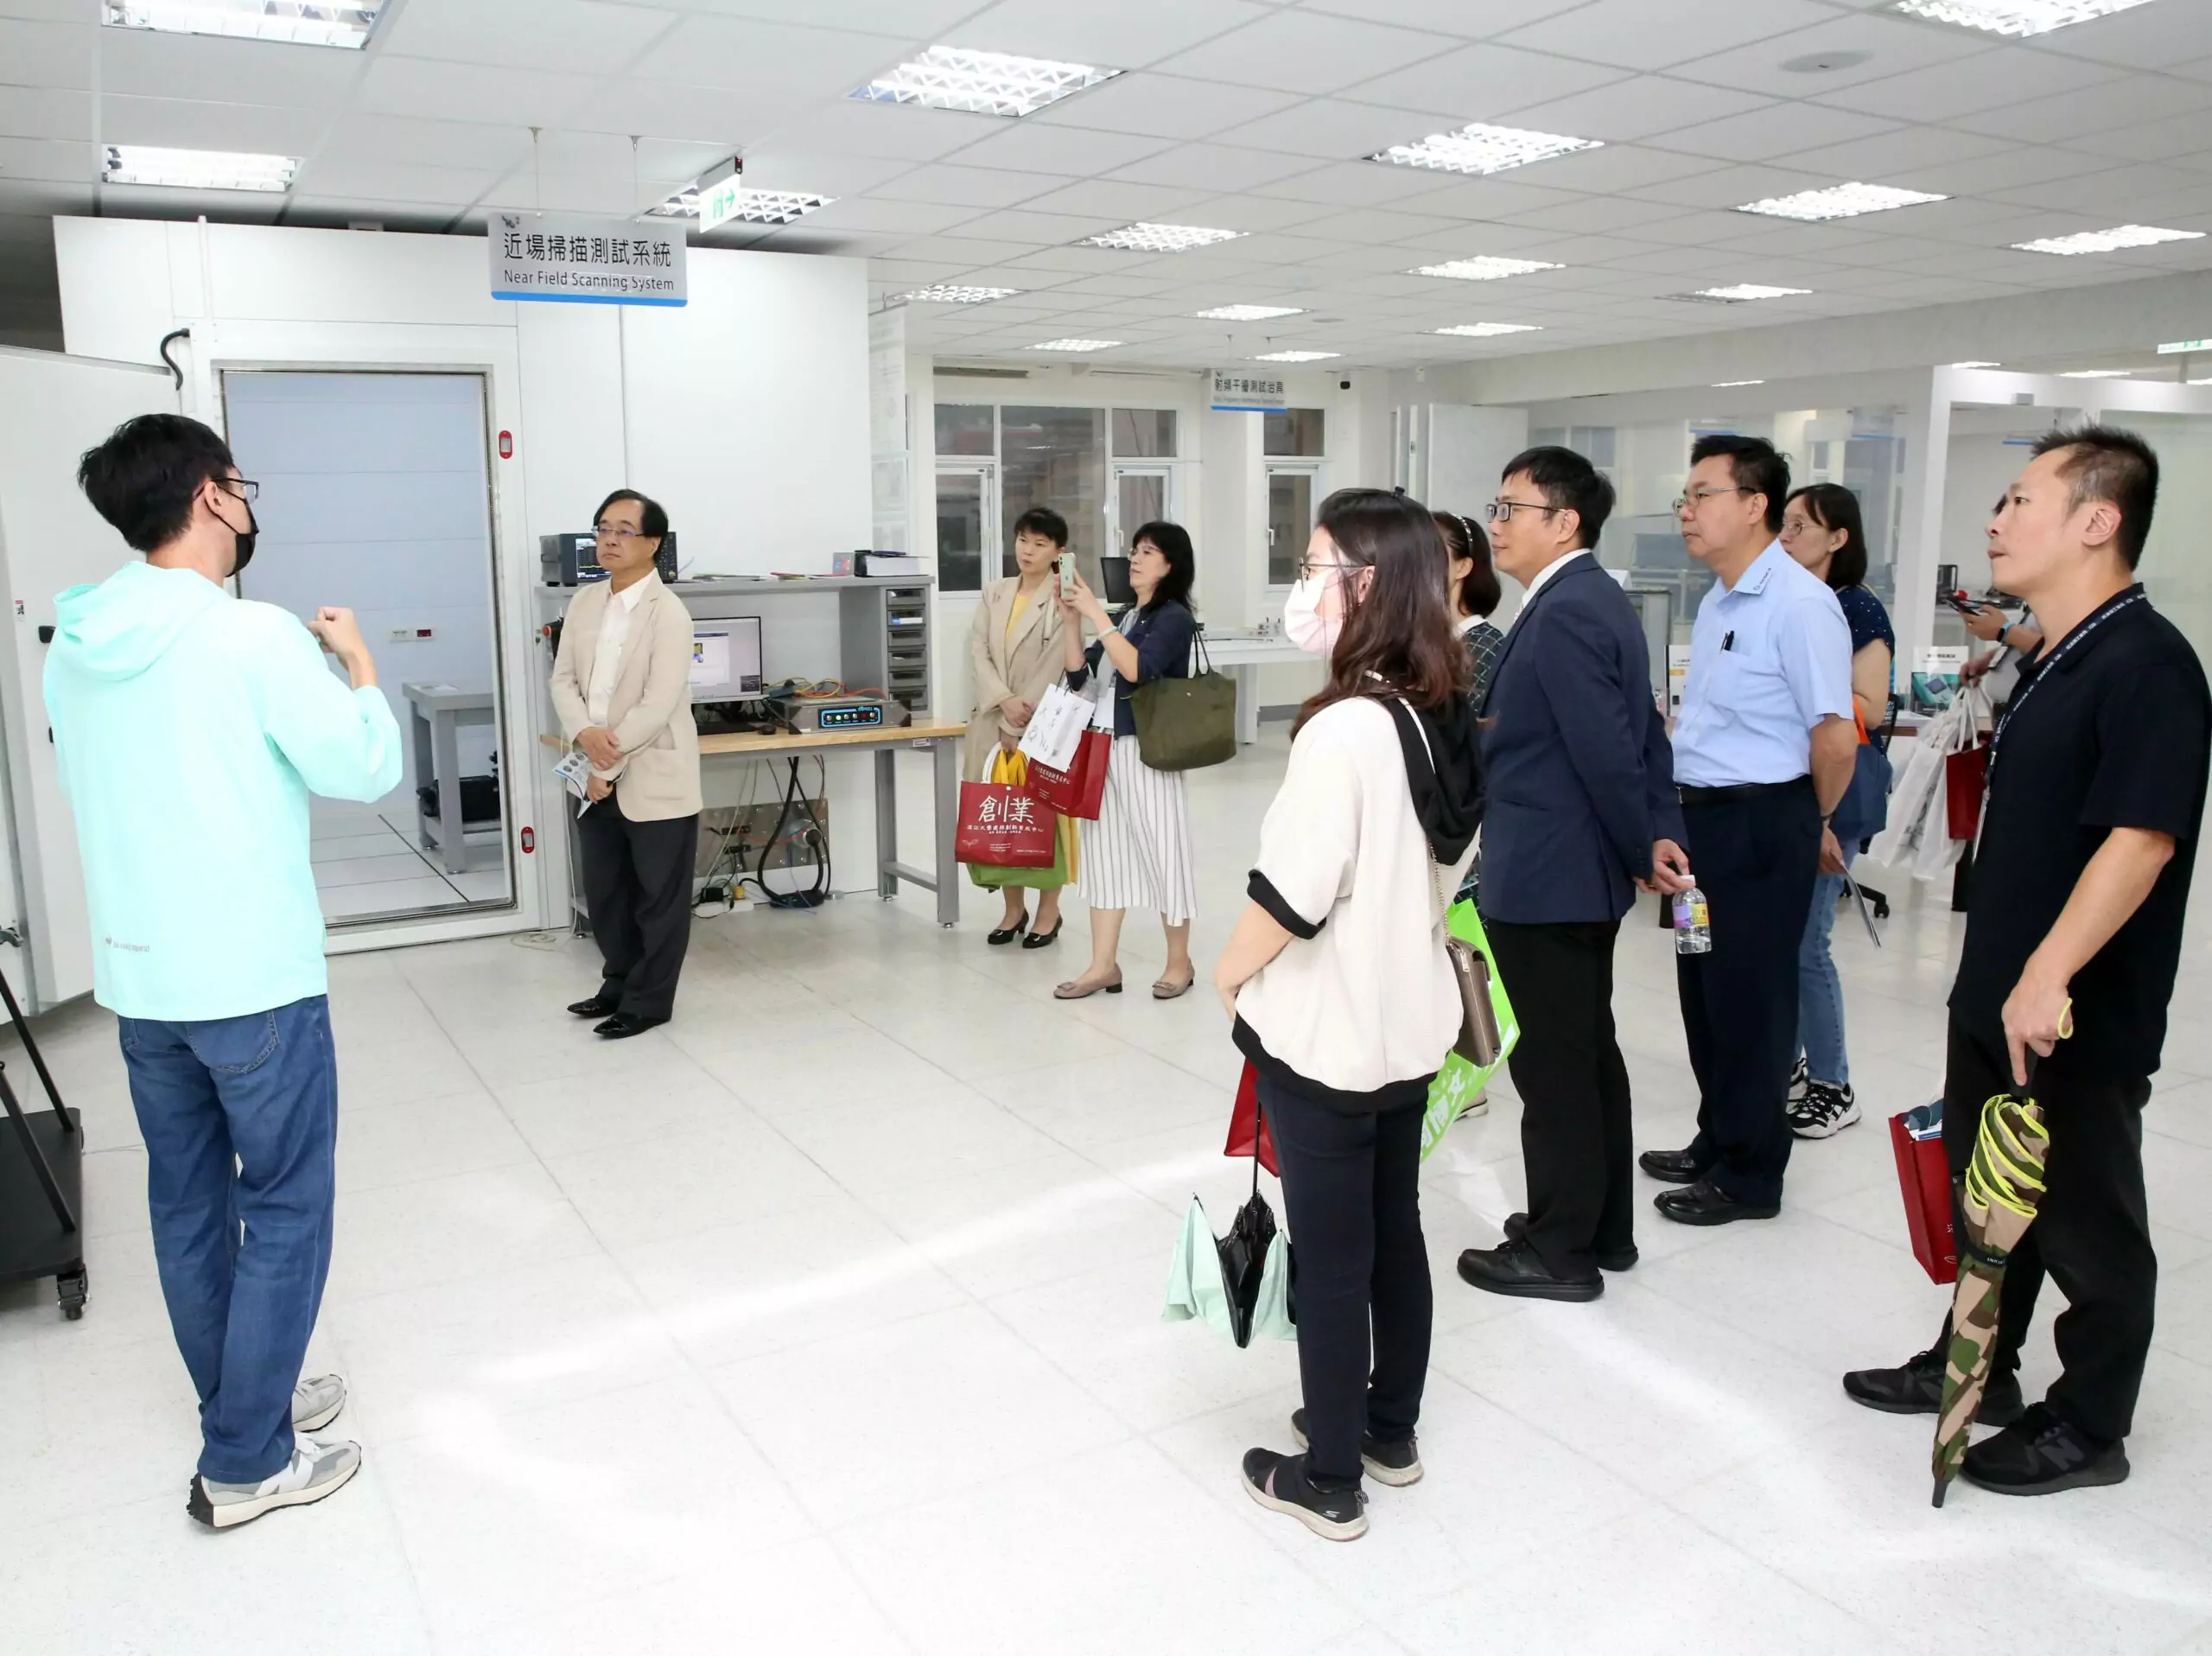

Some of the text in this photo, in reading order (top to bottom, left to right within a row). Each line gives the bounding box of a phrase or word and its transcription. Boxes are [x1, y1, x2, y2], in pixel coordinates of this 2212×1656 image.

[504, 232, 671, 267] 近場掃描測試系統
[505, 270, 674, 292] Near Field Scanning System
[978, 794, 1035, 825] 創業
